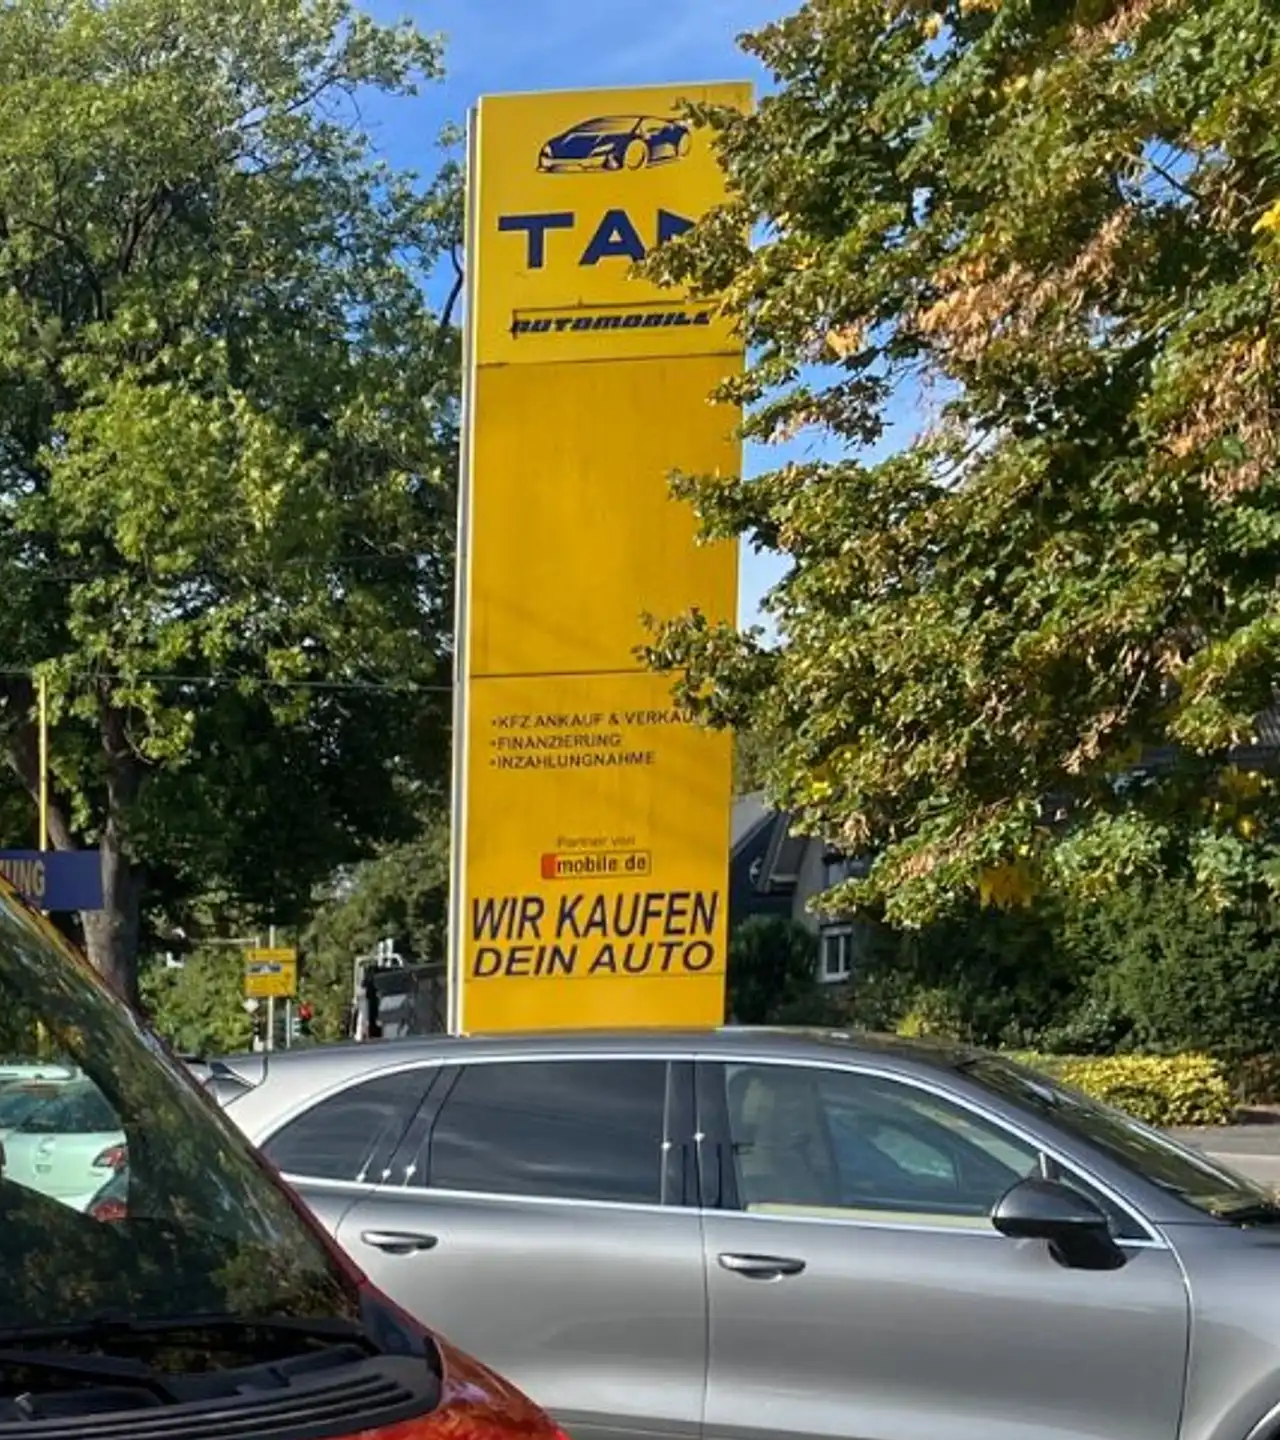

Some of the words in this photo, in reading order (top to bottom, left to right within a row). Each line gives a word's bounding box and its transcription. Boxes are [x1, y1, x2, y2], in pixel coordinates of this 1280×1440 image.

[533, 713, 604, 728] ANKAUF
[607, 712, 620, 726] &
[623, 709, 698, 725] VERKAU
[497, 733, 621, 750] FINANZIERUNG
[497, 751, 655, 769] INZAHLUNGNAHME
[472, 896, 545, 941] WIR
[555, 890, 719, 939] KAUFEN
[472, 944, 578, 977] DEIN
[588, 940, 715, 974] AUTO
